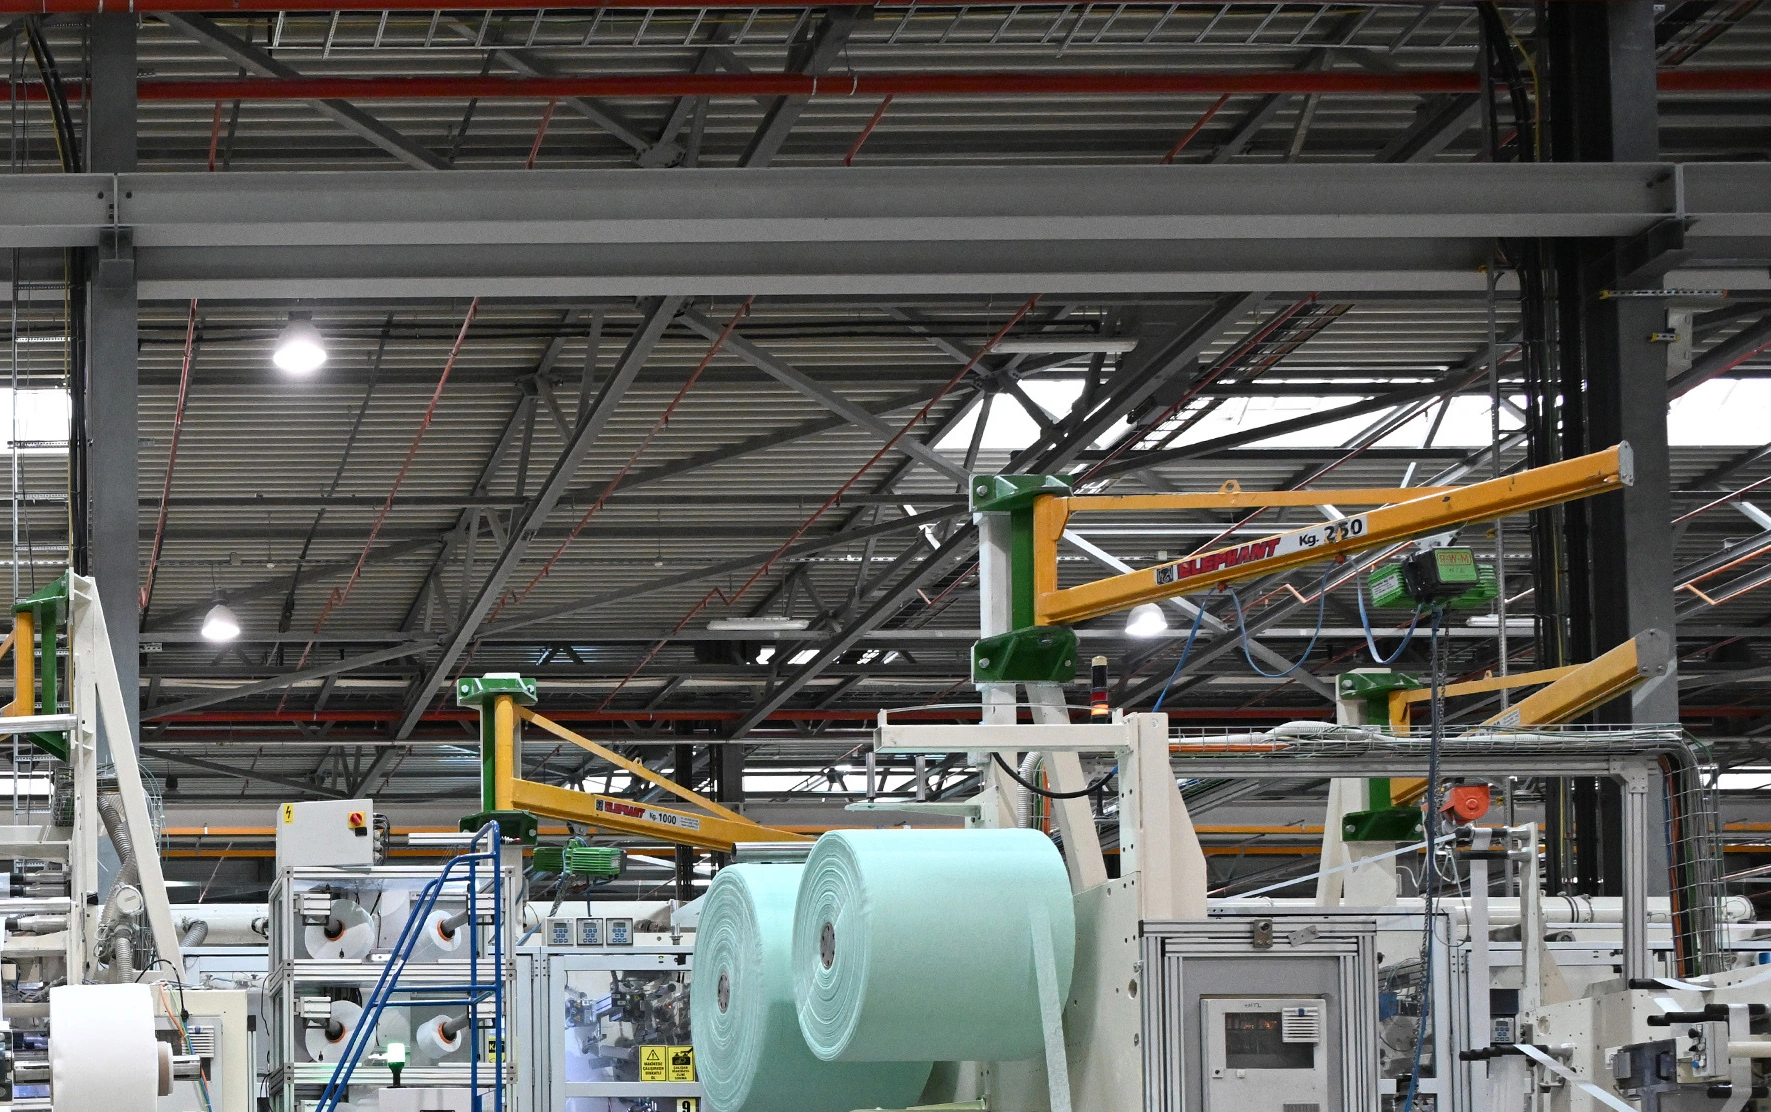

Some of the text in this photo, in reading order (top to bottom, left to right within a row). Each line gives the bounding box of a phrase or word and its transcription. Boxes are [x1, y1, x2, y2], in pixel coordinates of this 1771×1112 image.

[1178, 537, 1281, 580] ELEPHANT
[1299, 533, 1320, 548] Kg.
[658, 812, 677, 825] 1000
